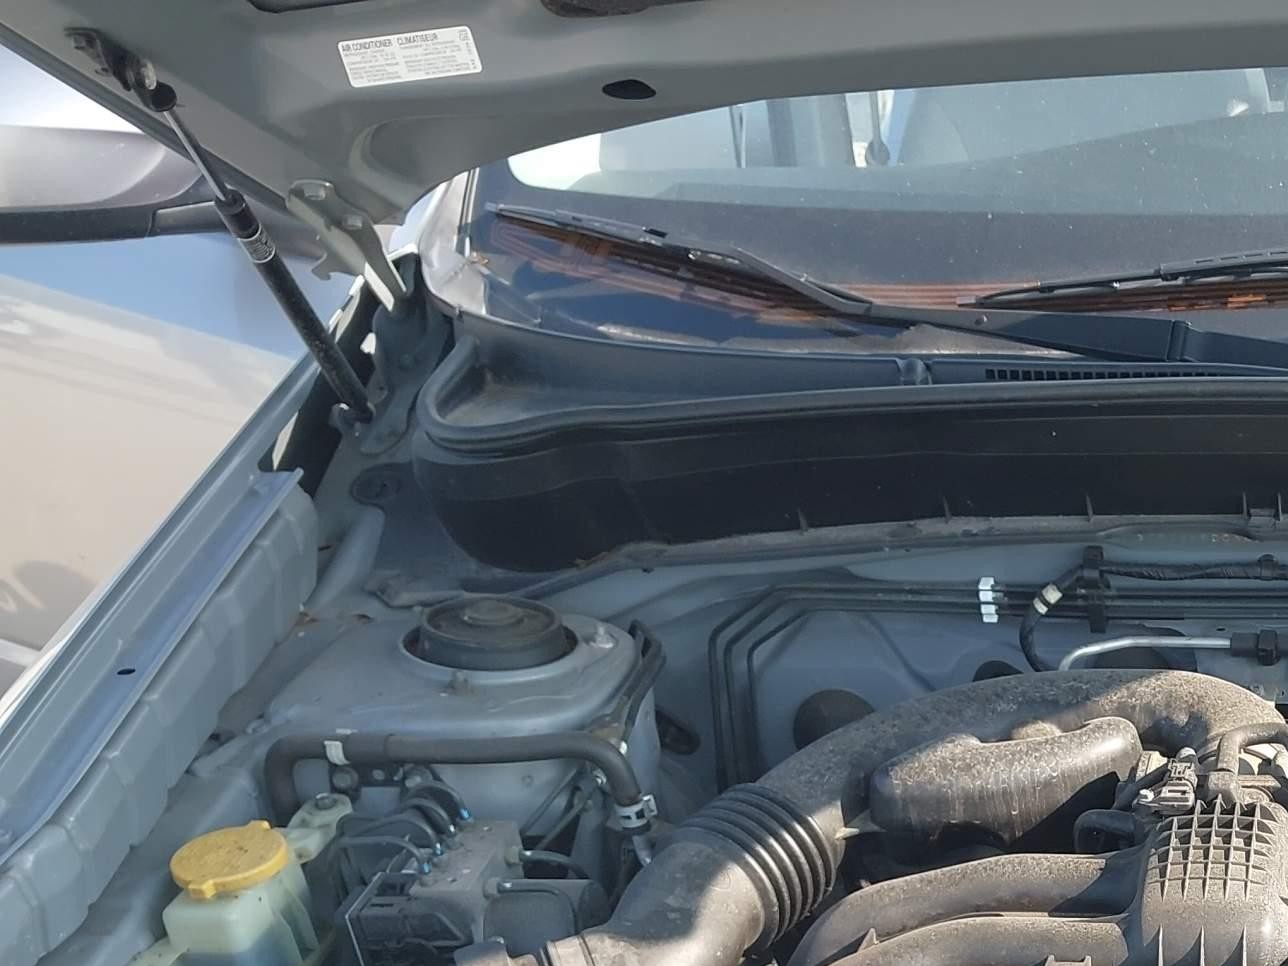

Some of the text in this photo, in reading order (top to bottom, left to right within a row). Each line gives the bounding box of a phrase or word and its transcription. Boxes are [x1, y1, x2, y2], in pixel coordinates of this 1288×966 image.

[341, 32, 438, 52] AIR CONDITIONER CLIMATISEUR
